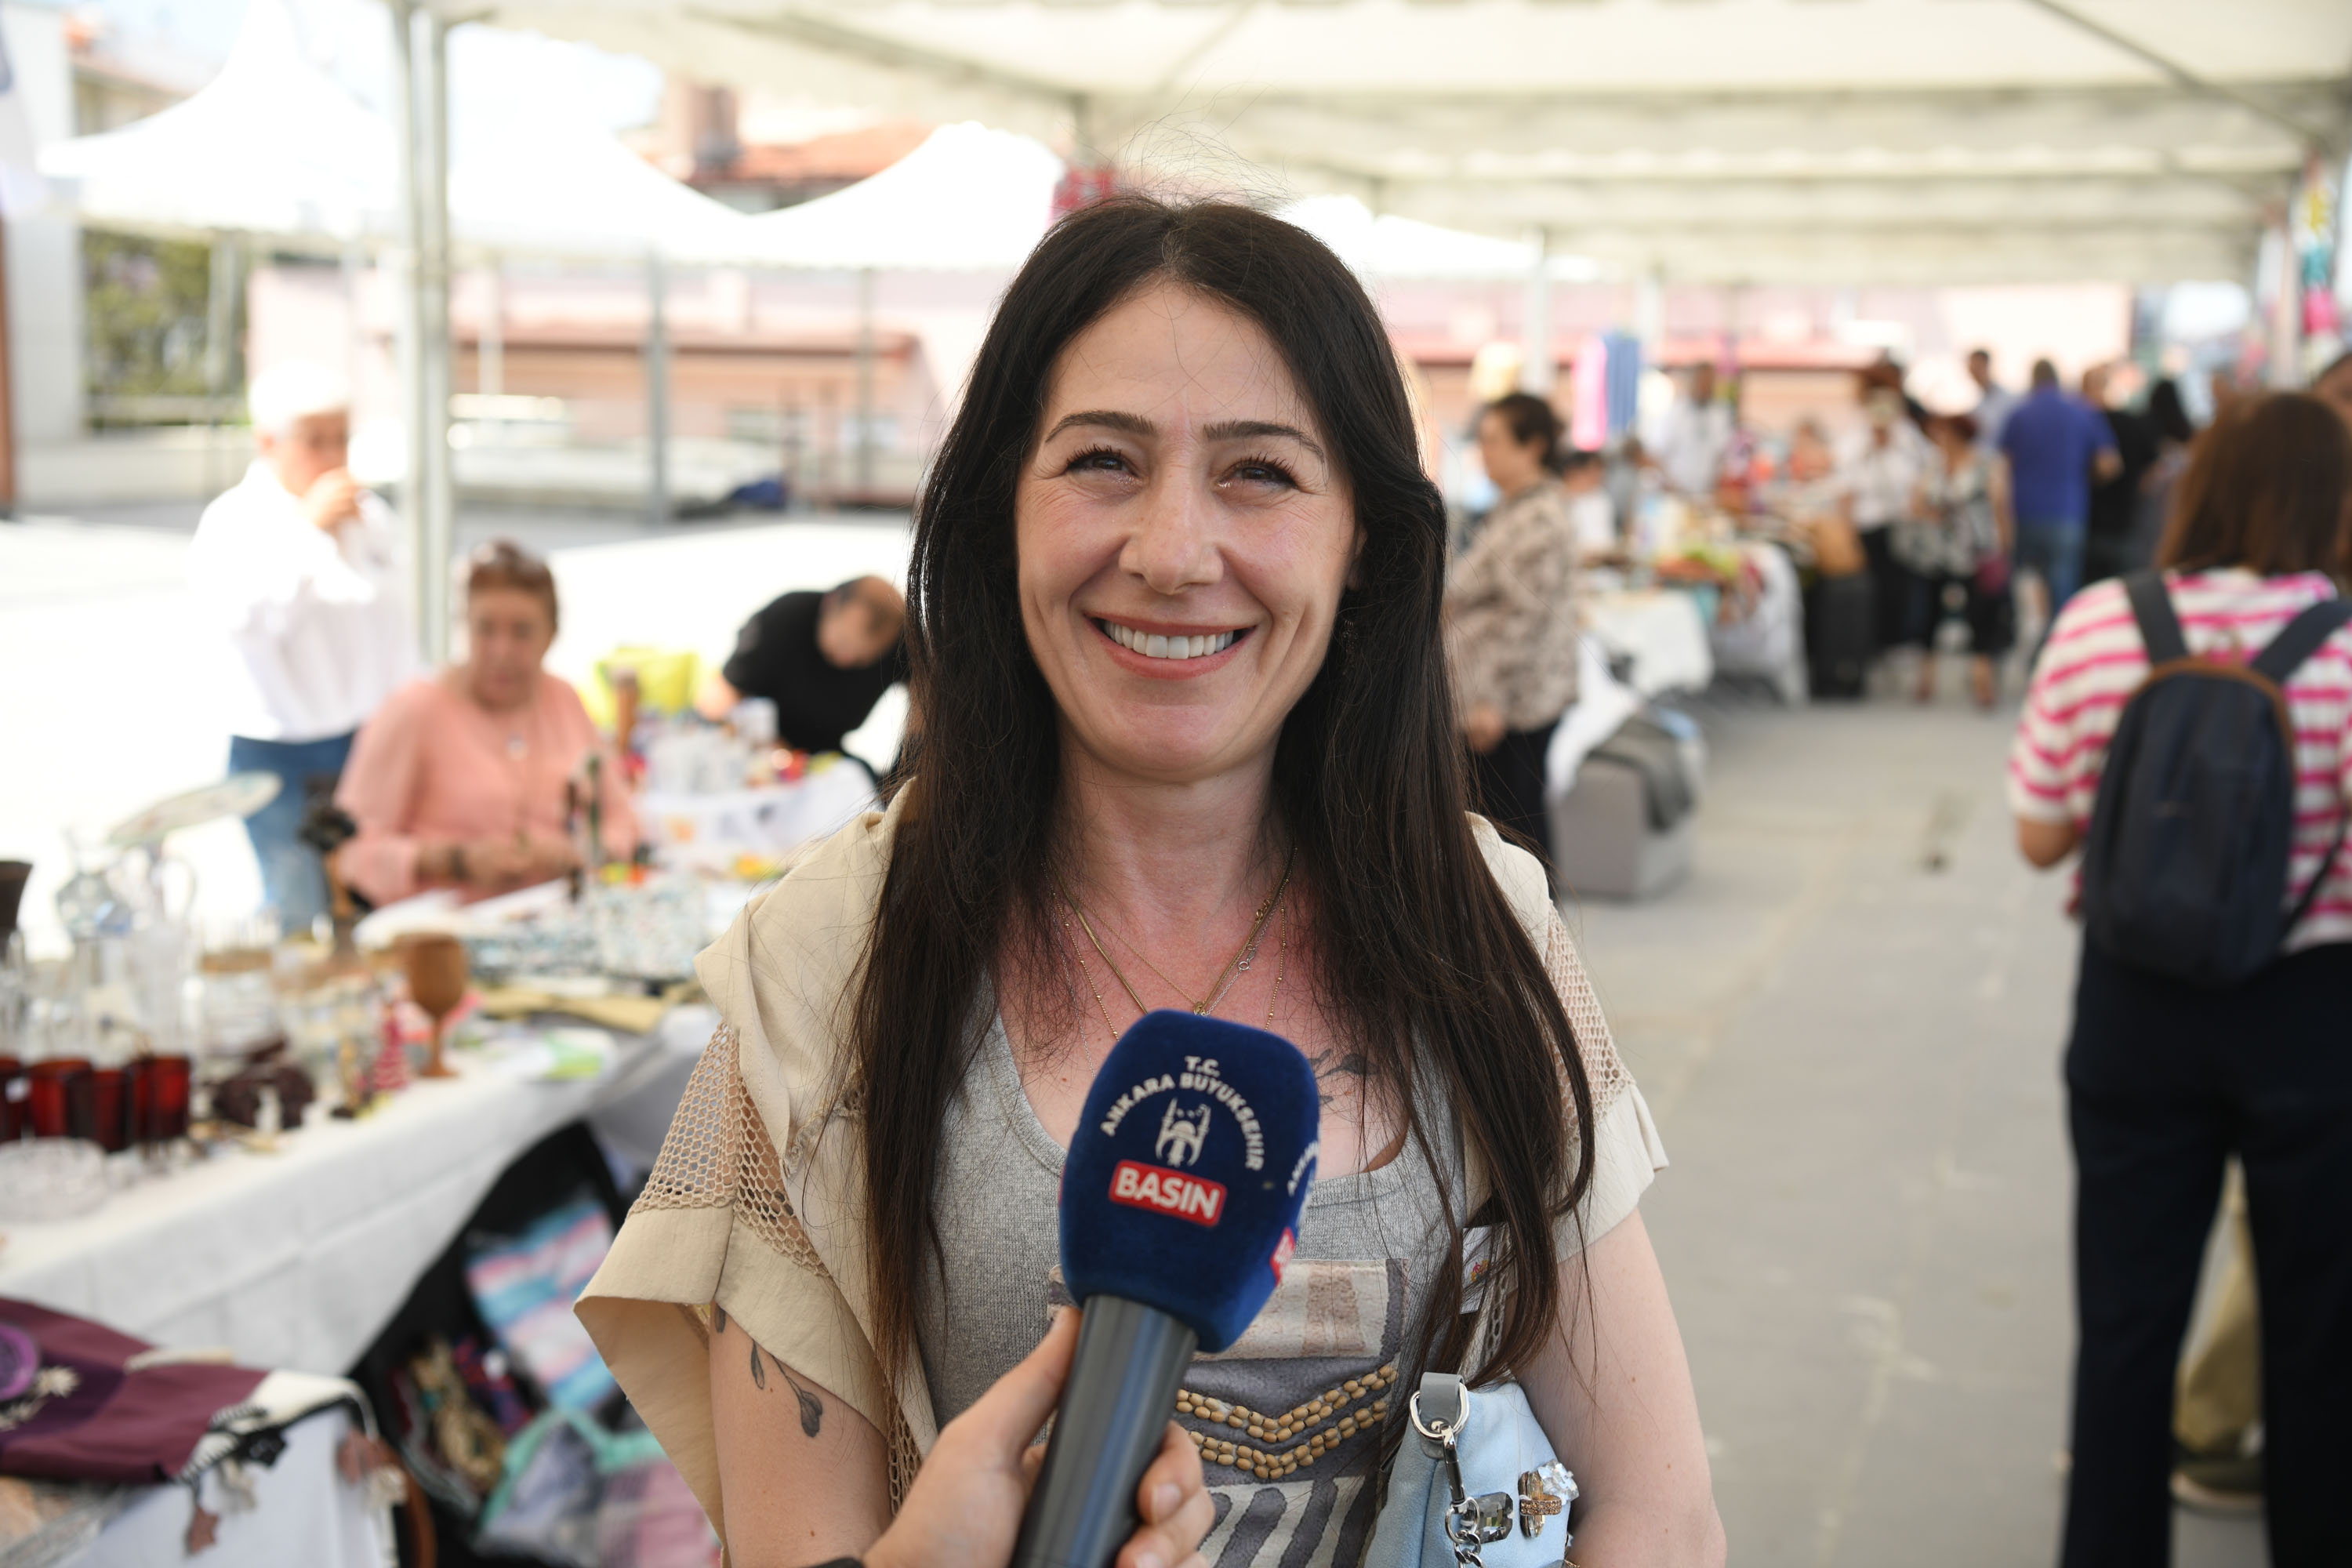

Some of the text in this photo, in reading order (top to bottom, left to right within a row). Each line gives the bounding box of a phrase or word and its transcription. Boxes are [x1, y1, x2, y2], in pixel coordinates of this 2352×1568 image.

[1184, 1055, 1220, 1078] T.C.
[1100, 1073, 1176, 1137] ANKARA
[1115, 1167, 1220, 1219] BASIN
